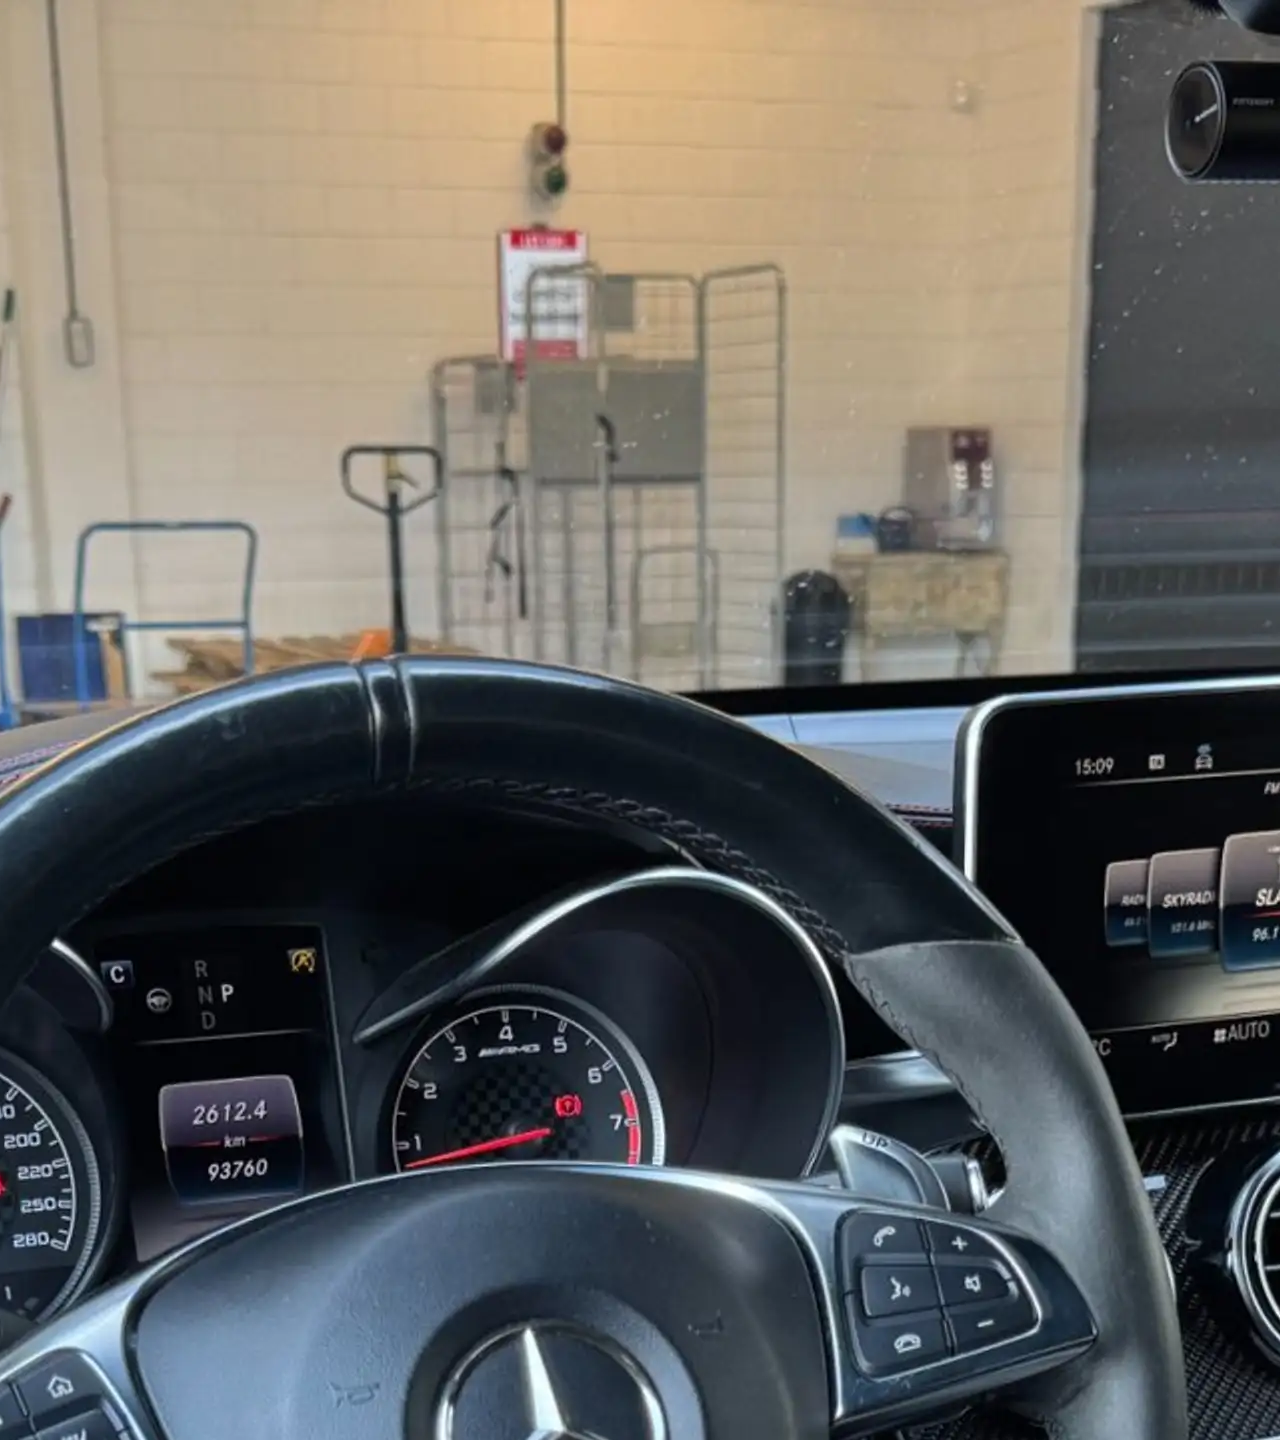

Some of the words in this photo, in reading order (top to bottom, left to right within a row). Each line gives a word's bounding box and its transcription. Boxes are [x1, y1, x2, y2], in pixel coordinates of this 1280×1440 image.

[1075, 757, 1114, 776] 15:09
[1252, 926, 1279, 942] 96.1
[110, 965, 125, 984] C
[195, 960, 208, 978] R
[198, 986, 213, 1005] N
[221, 984, 234, 1003] P
[201, 1011, 216, 1030] D
[499, 1025, 513, 1041] 4
[1228, 1020, 1270, 1042] AUTO
[553, 1037, 568, 1053] 5
[453, 1046, 467, 1062] 3
[588, 1068, 603, 1084] 6
[423, 1083, 438, 1099] 2
[192, 1099, 268, 1125] 2612.4
[609, 1114, 622, 1131] 7
[3, 1131, 41, 1149] 200
[224, 1134, 246, 1149] km
[414, 1135, 422, 1151] 1
[17, 1164, 54, 1180] 220
[207, 1158, 268, 1182] 93760
[20, 1198, 57, 1213] 250
[13, 1231, 51, 1248] 280
